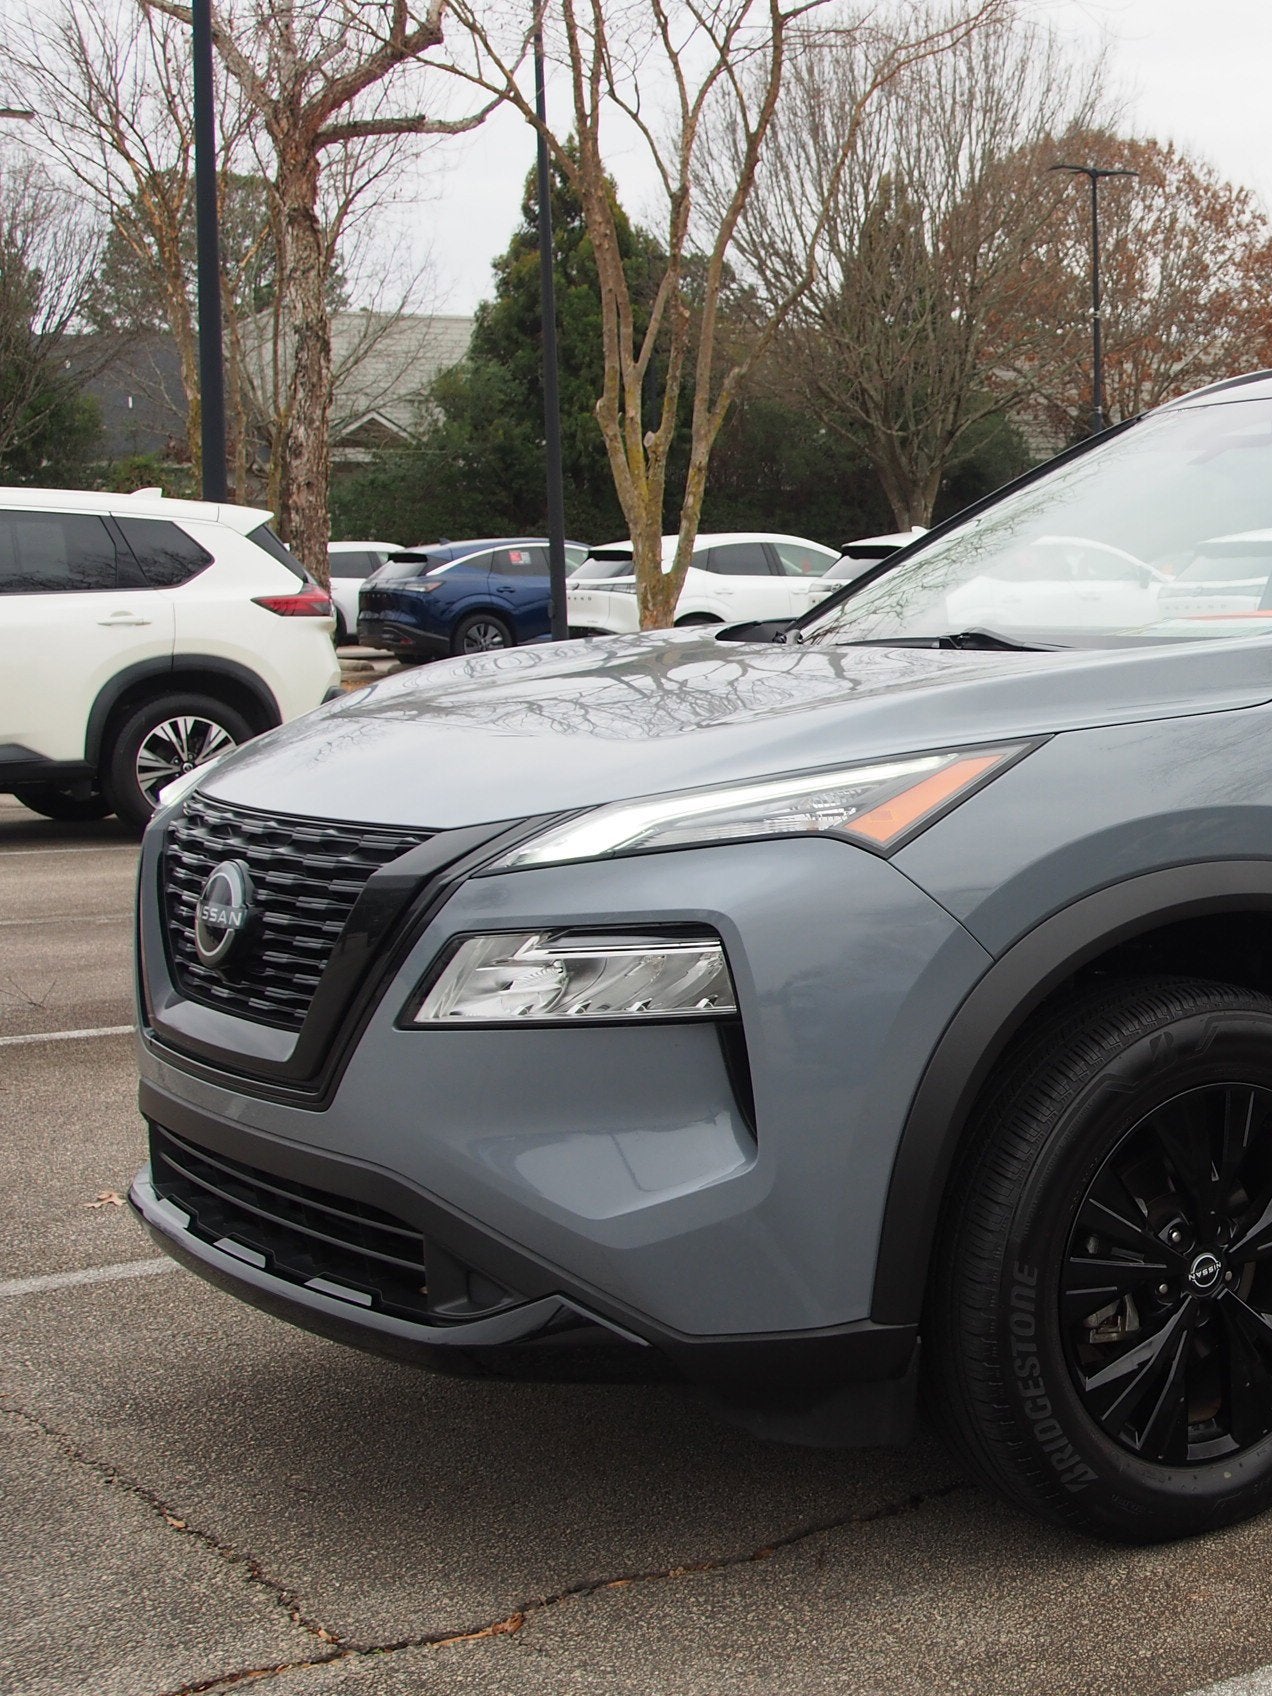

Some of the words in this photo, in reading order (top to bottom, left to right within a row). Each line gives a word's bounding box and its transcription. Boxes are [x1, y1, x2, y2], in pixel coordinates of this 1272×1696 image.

[201, 905, 242, 926] SSAN
[1188, 1261, 1222, 1281] NISSAN
[1009, 1261, 1099, 1494] BRIDGESTONE
